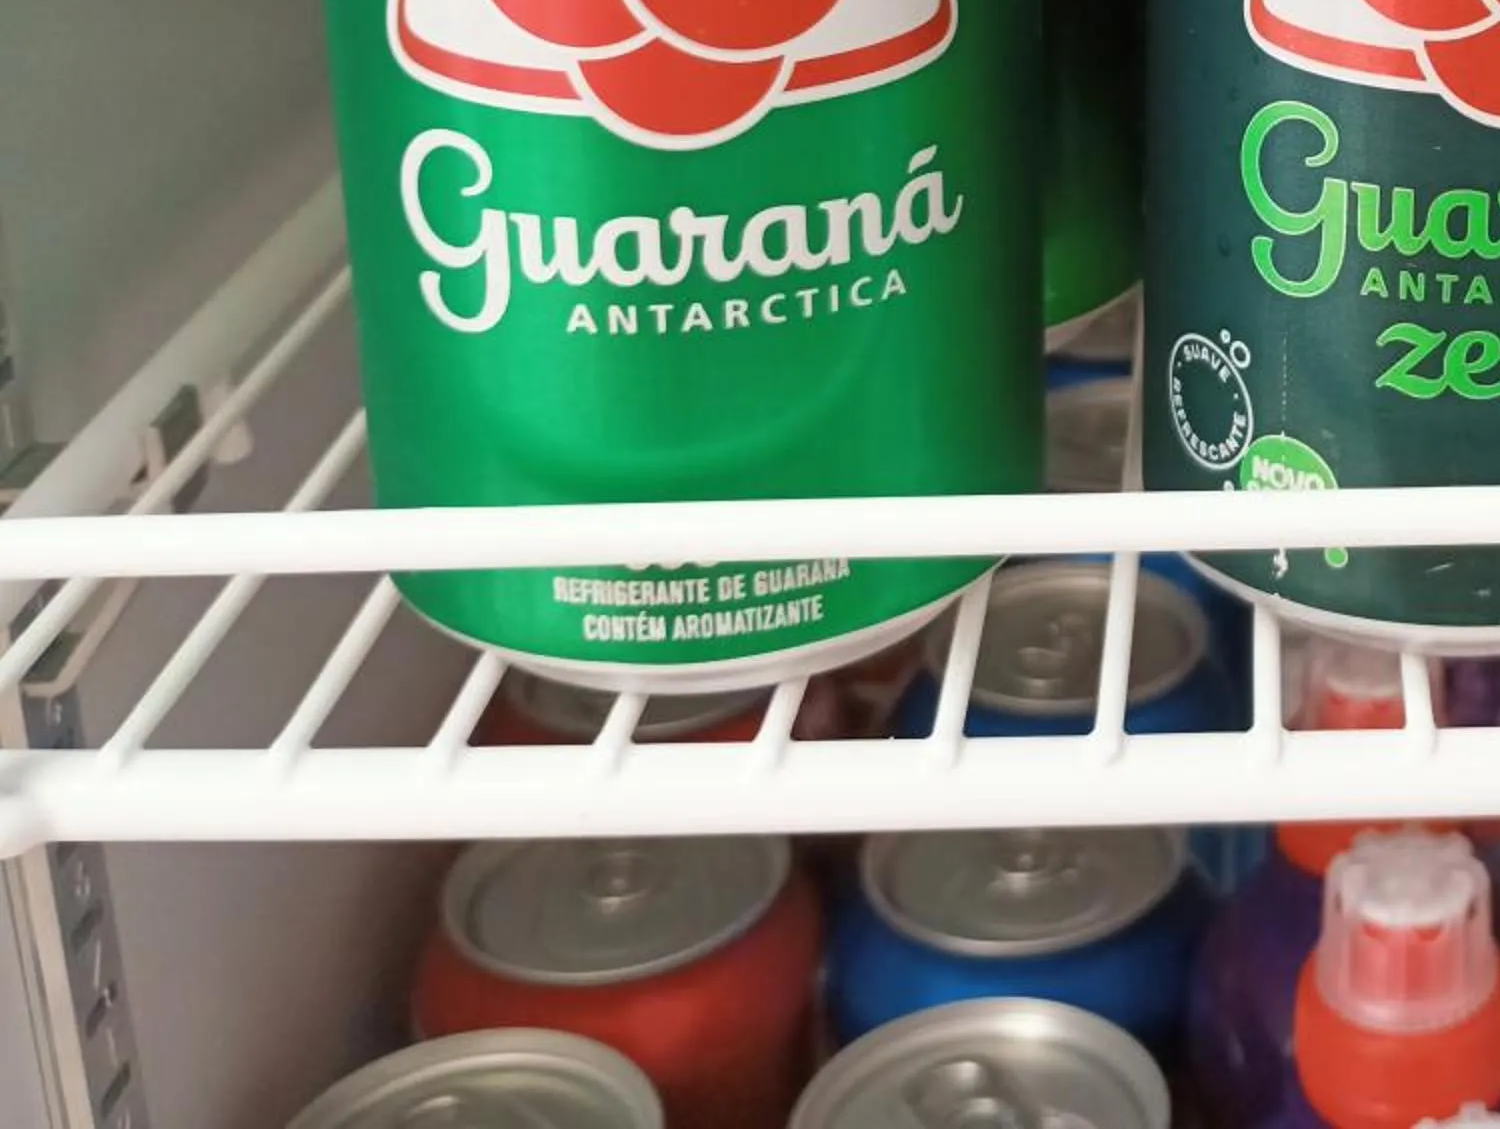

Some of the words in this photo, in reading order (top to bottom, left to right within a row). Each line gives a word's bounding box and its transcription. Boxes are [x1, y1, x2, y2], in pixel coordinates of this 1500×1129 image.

[401, 128, 963, 334] Guaraná
[566, 268, 907, 335] ANTARCTICA
[1183, 343, 1231, 383] SUAVE
[1172, 377, 1247, 461] REFRESCANTE
[1252, 455, 1326, 490] NOVO
[553, 576, 711, 607] REFRIGERANTE
[717, 574, 747, 603] DE
[583, 610, 667, 642] CONTÉM
[671, 594, 824, 641] AROMATIZANTE
